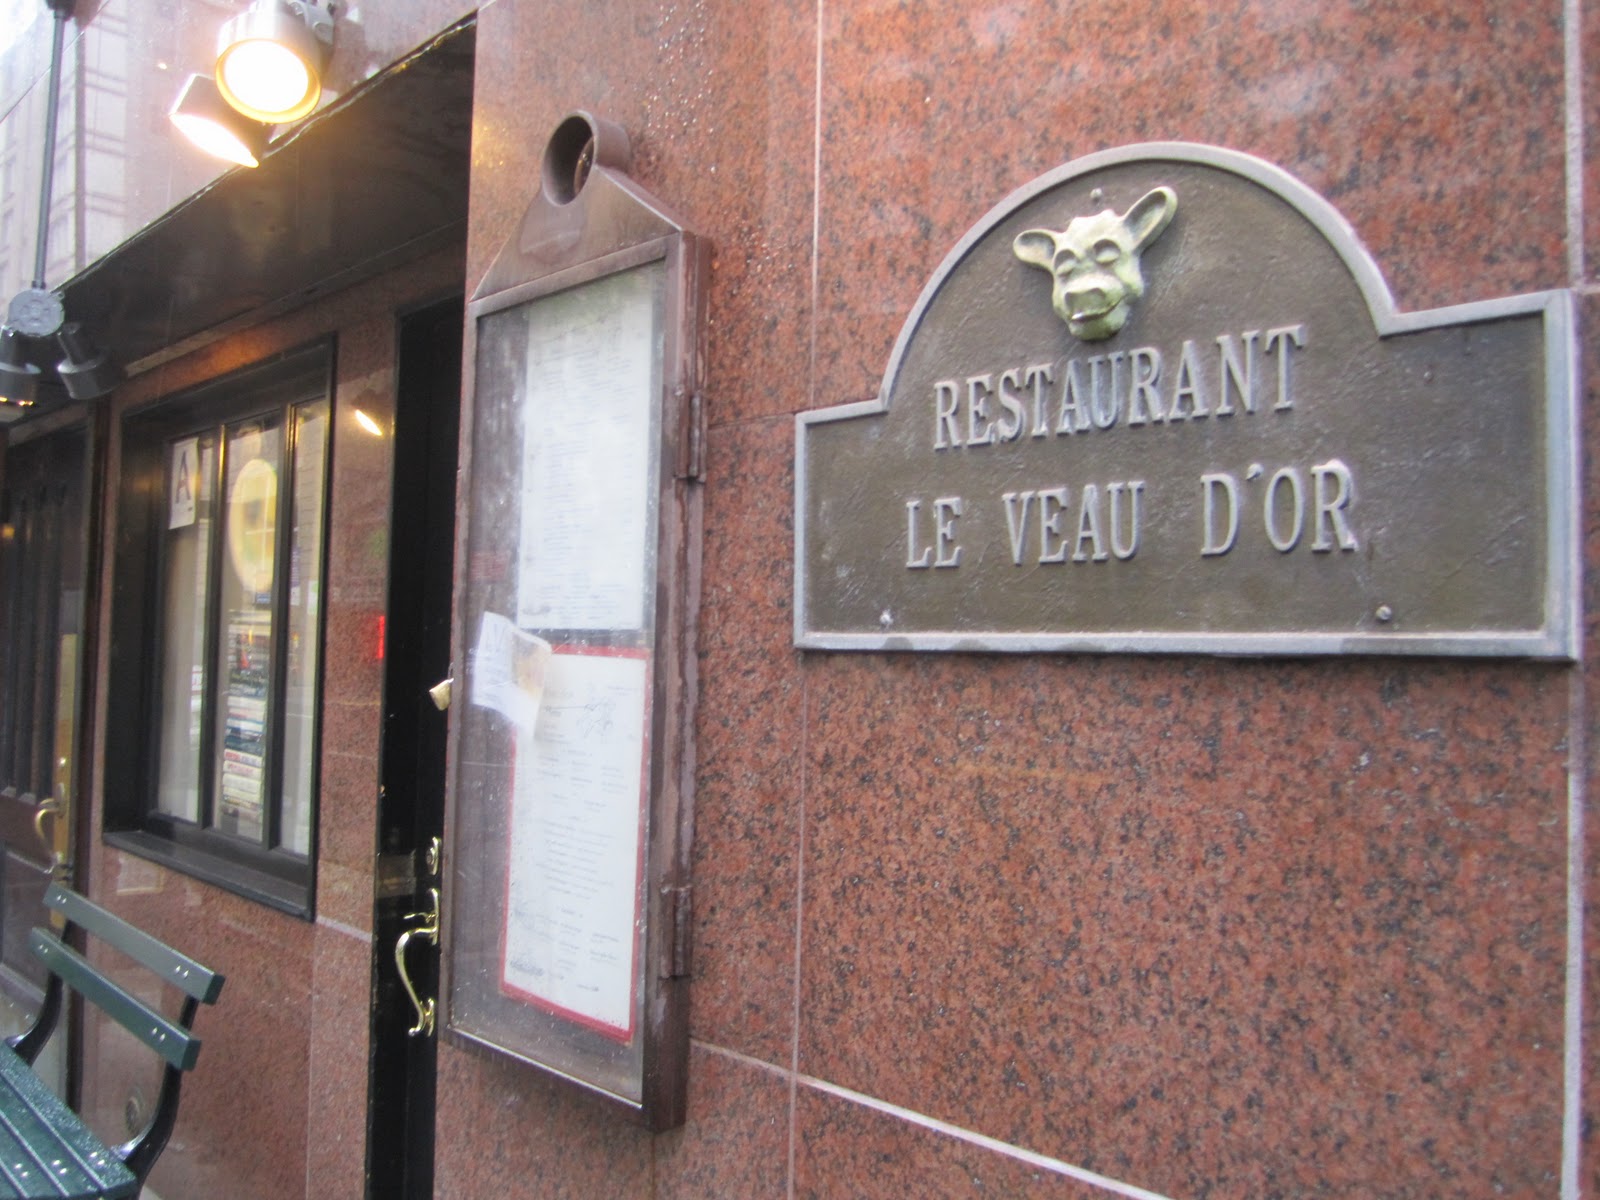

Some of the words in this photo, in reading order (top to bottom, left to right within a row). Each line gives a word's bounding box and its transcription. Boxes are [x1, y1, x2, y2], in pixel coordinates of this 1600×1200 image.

[933, 324, 1304, 450] RESTAURANT
[175, 449, 192, 504] A
[905, 496, 963, 569] LE
[1002, 480, 1145, 565] VEAU
[1200, 457, 1359, 557] D'OR
